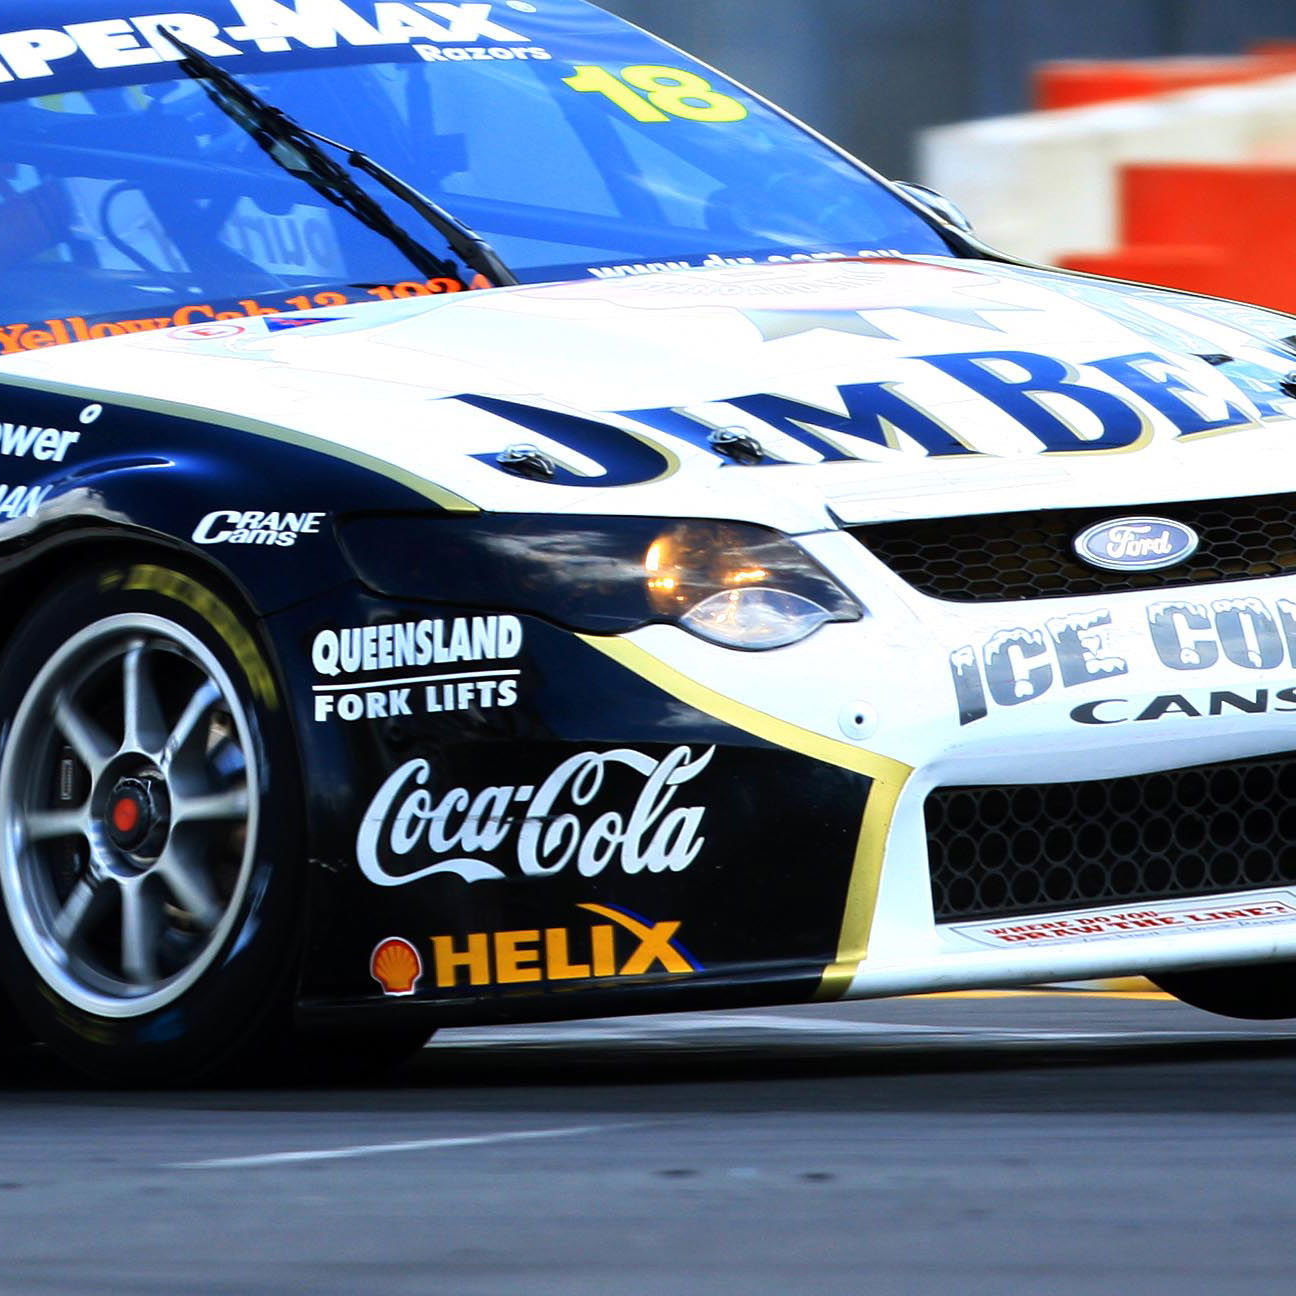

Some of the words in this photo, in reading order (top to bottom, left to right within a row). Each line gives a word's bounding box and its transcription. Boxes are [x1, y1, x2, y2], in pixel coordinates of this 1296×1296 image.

[413, 42, 552, 62] Razors
[561, 64, 748, 123] 18
[192, 510, 326, 545] CRANE
[1106, 524, 1173, 559] Ford
[312, 615, 524, 677] QUEENSLAND
[948, 608, 1128, 727] ICE
[314, 688, 413, 722] FORK
[427, 679, 519, 713] LIFTS
[356, 744, 717, 887] Coca-Cola
[983, 920, 1074, 936] WHERE
[1076, 915, 1112, 926] DO
[1111, 910, 1159, 920] YOU
[996, 923, 1105, 943] DRAW
[1106, 916, 1185, 930] THE
[1185, 905, 1288, 922] LINE?
[429, 903, 706, 988] HELIX
